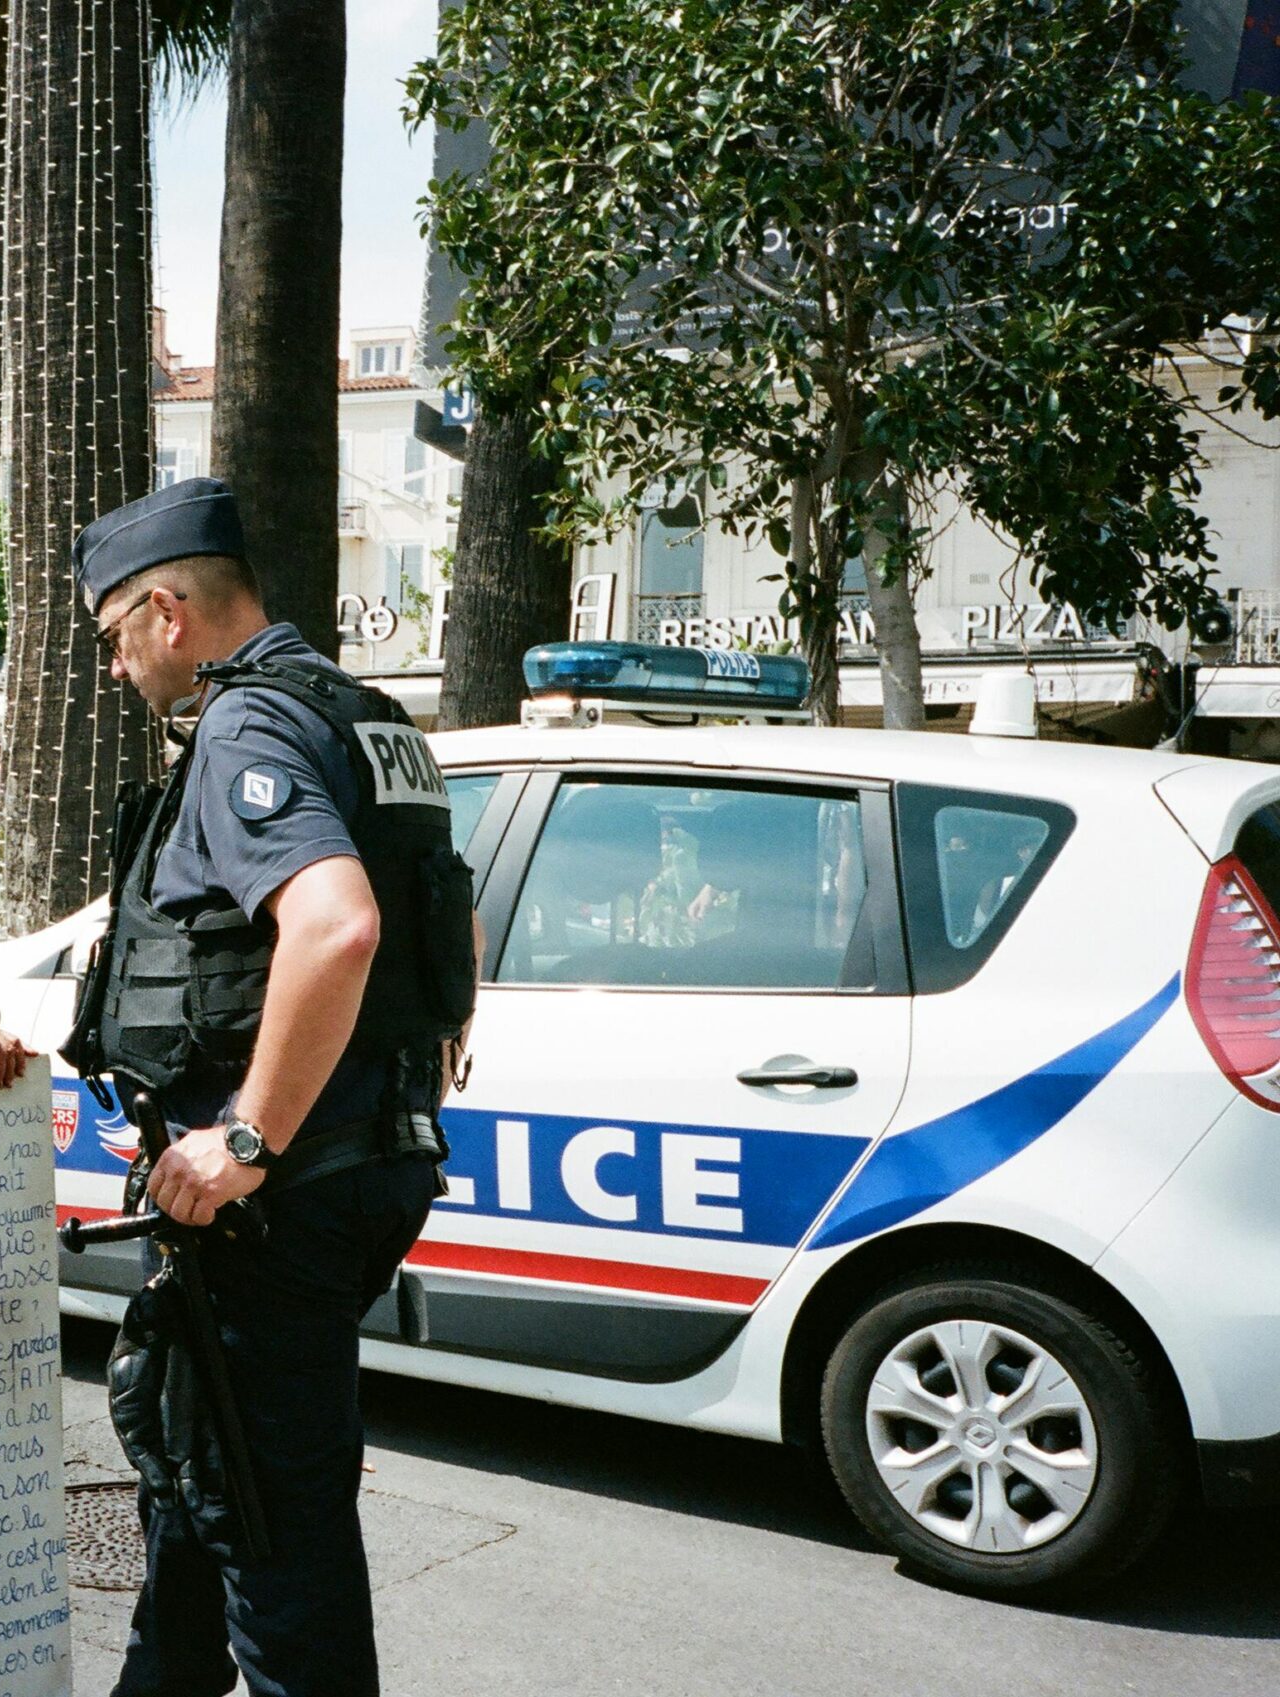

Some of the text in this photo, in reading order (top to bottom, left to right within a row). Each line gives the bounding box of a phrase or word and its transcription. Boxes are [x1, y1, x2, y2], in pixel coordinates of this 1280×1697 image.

[660, 610, 877, 650] RESTAUAN
[962, 600, 1085, 643] PIZZA
[702, 649, 758, 676] POLICE
[368, 733, 448, 797] POLIC
[3, 1141, 42, 1169] pas
[10, 1469, 51, 1497] son
[21, 1505, 47, 1532] la
[43, 1537, 68, 1572] que
[39, 1568, 60, 1596] le
